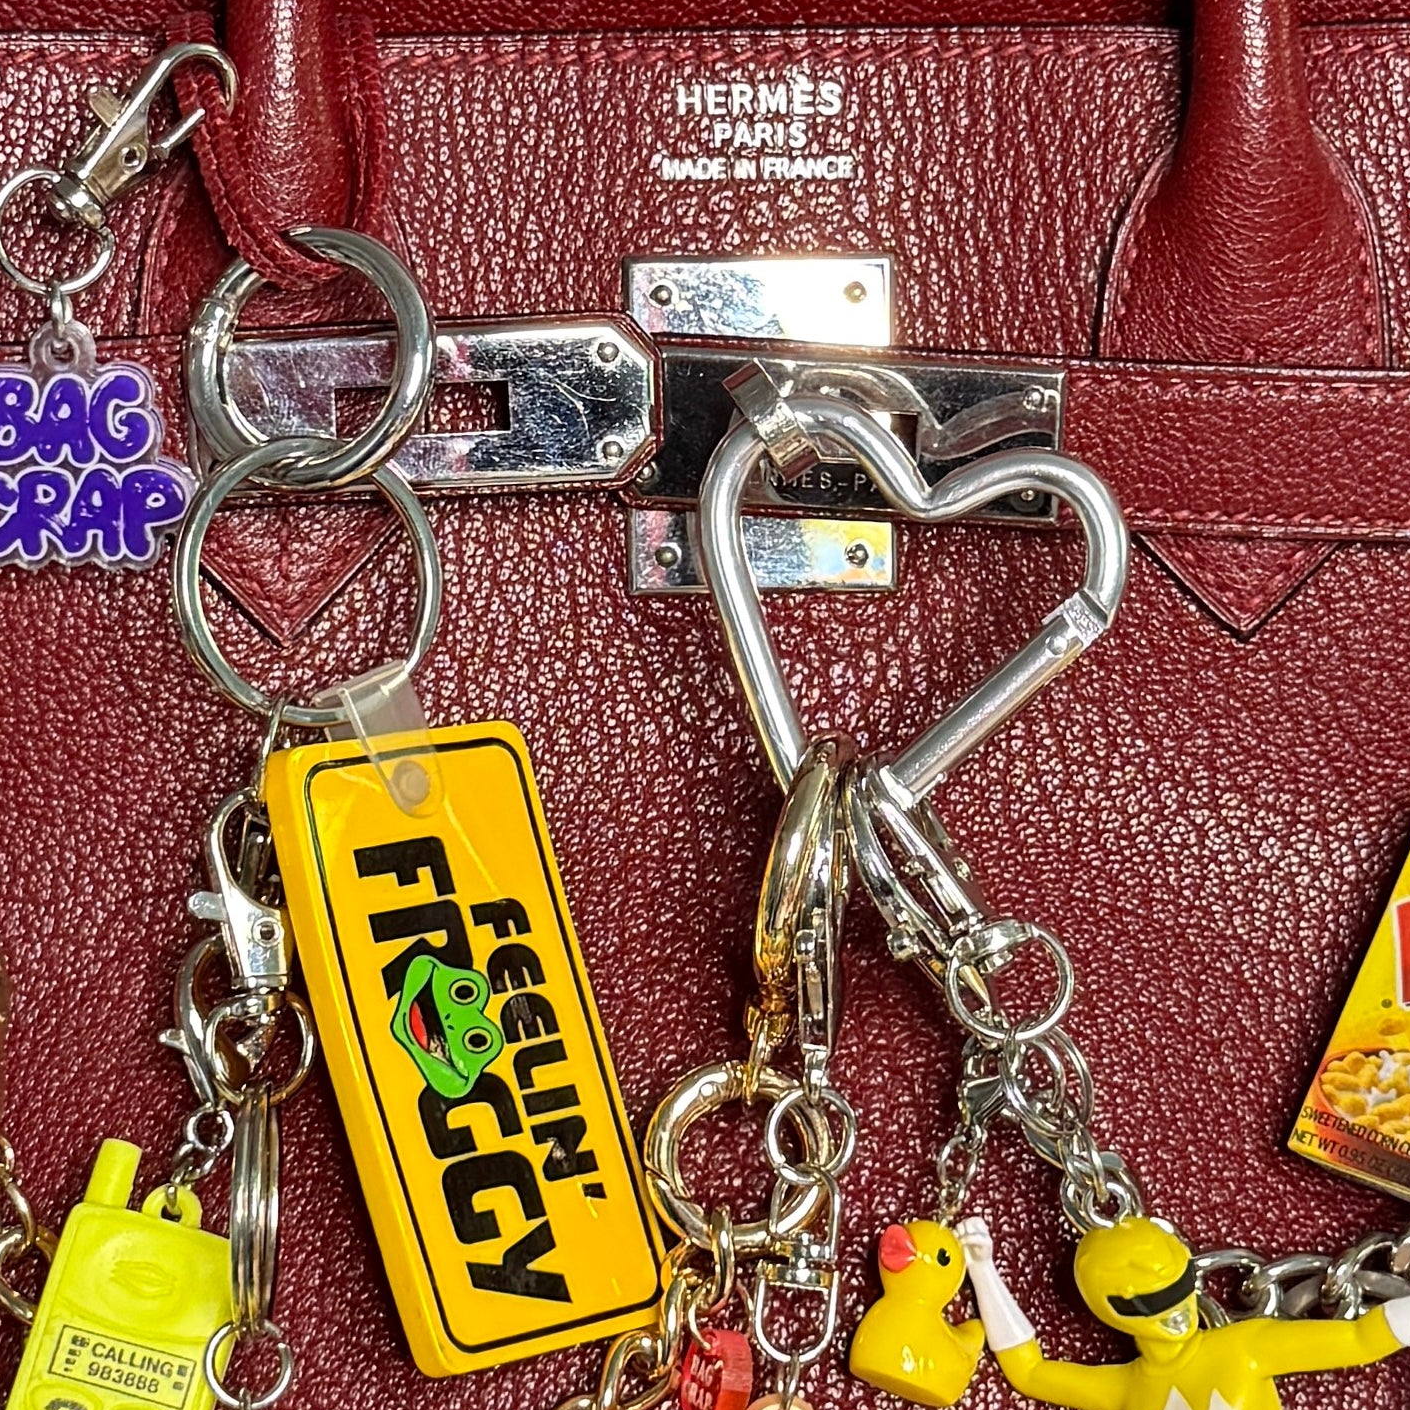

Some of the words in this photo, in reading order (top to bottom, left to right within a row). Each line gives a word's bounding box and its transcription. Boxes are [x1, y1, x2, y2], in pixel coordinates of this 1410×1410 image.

[713, 121, 807, 148] PARIS
[661, 157, 727, 181] MADE
[734, 158, 757, 181] IN
[763, 156, 858, 181] FRANCE
[1291, 1128, 1318, 1146] NET
[1317, 1135, 1341, 1154] WT
[1300, 1106, 1367, 1138] SWEETENED
[1367, 1128, 1400, 1151] CORN
[91, 1342, 174, 1379] CALLING
[88, 1361, 160, 1394] 983888
